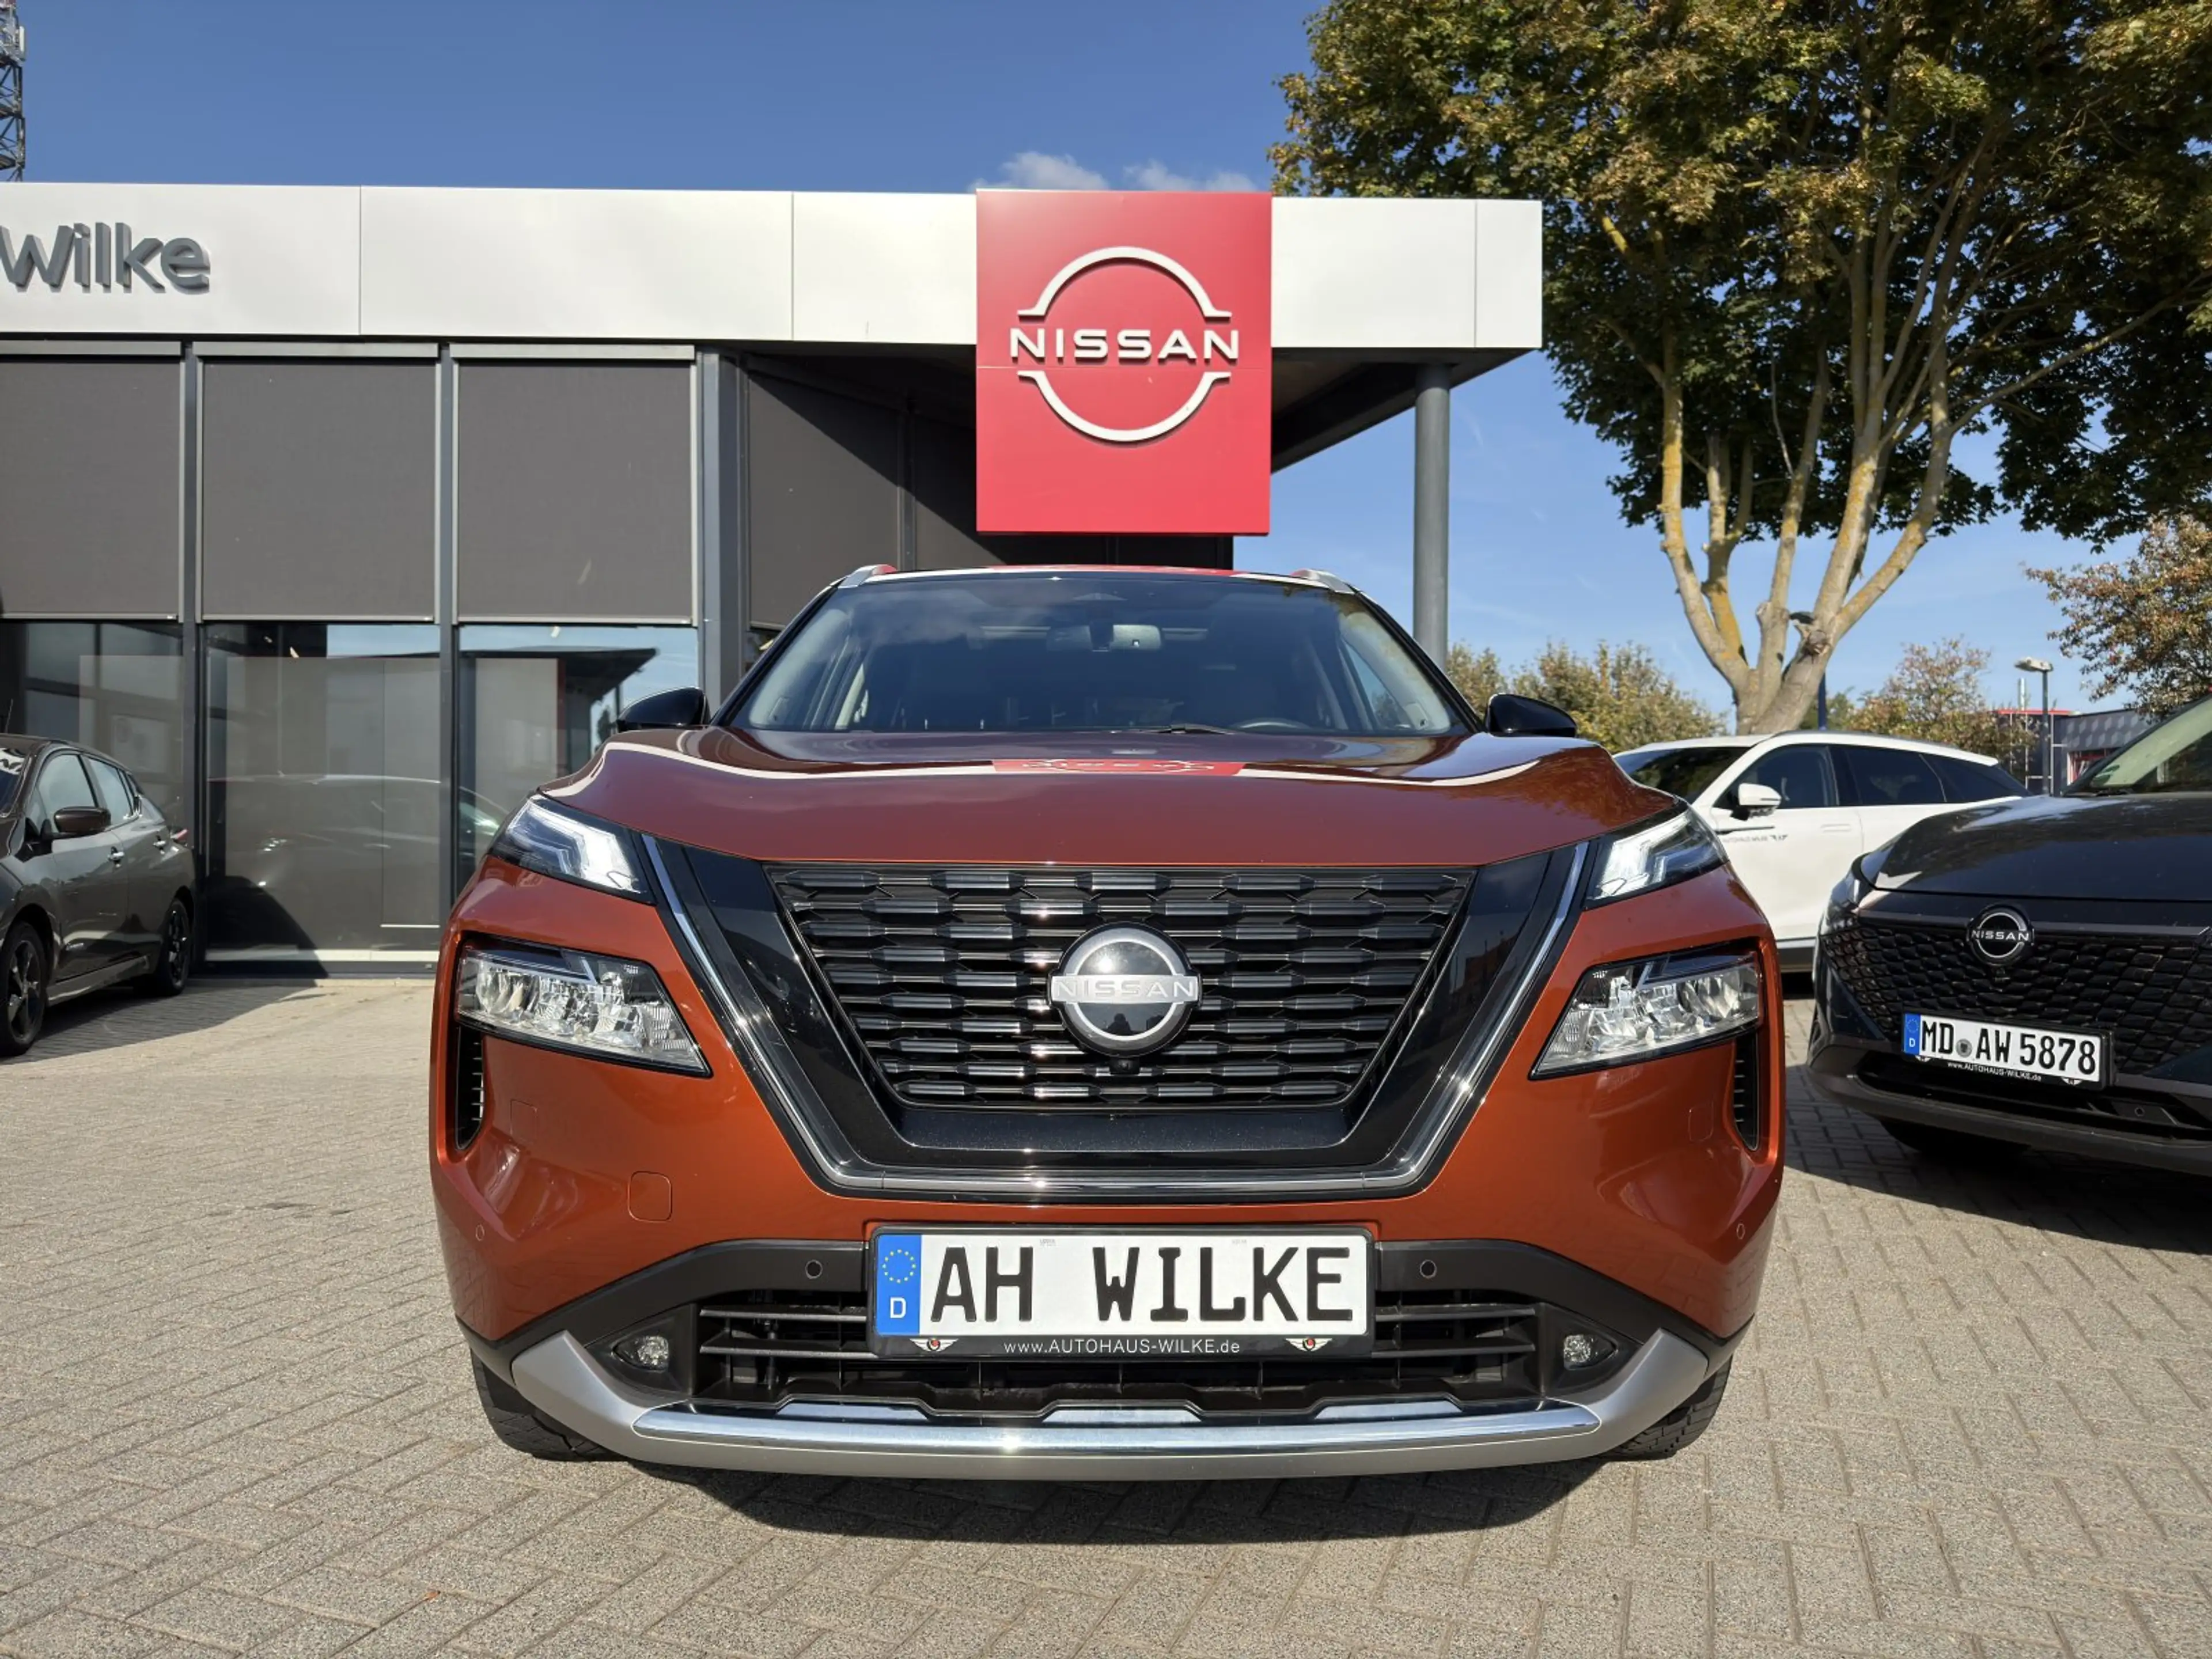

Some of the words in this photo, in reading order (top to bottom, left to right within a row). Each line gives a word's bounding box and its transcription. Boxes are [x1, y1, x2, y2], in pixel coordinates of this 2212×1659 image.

[0, 222, 210, 290] Wilke
[1010, 328, 1239, 362] NISSAN
[1971, 929, 2029, 942] NISSAN
[1056, 979, 1194, 998] NISSAN
[1909, 1038, 1916, 1048] D
[1921, 1020, 1955, 1055] MD
[1975, 1028, 2011, 1063] AW
[2020, 1032, 2096, 1075] 5878
[930, 1246, 1034, 1323] AH
[1092, 1246, 1353, 1323] WILKE
[890, 1297, 907, 1319] D
[1003, 1338, 1241, 1354] www.AUTOHAUS-WILKE.de
